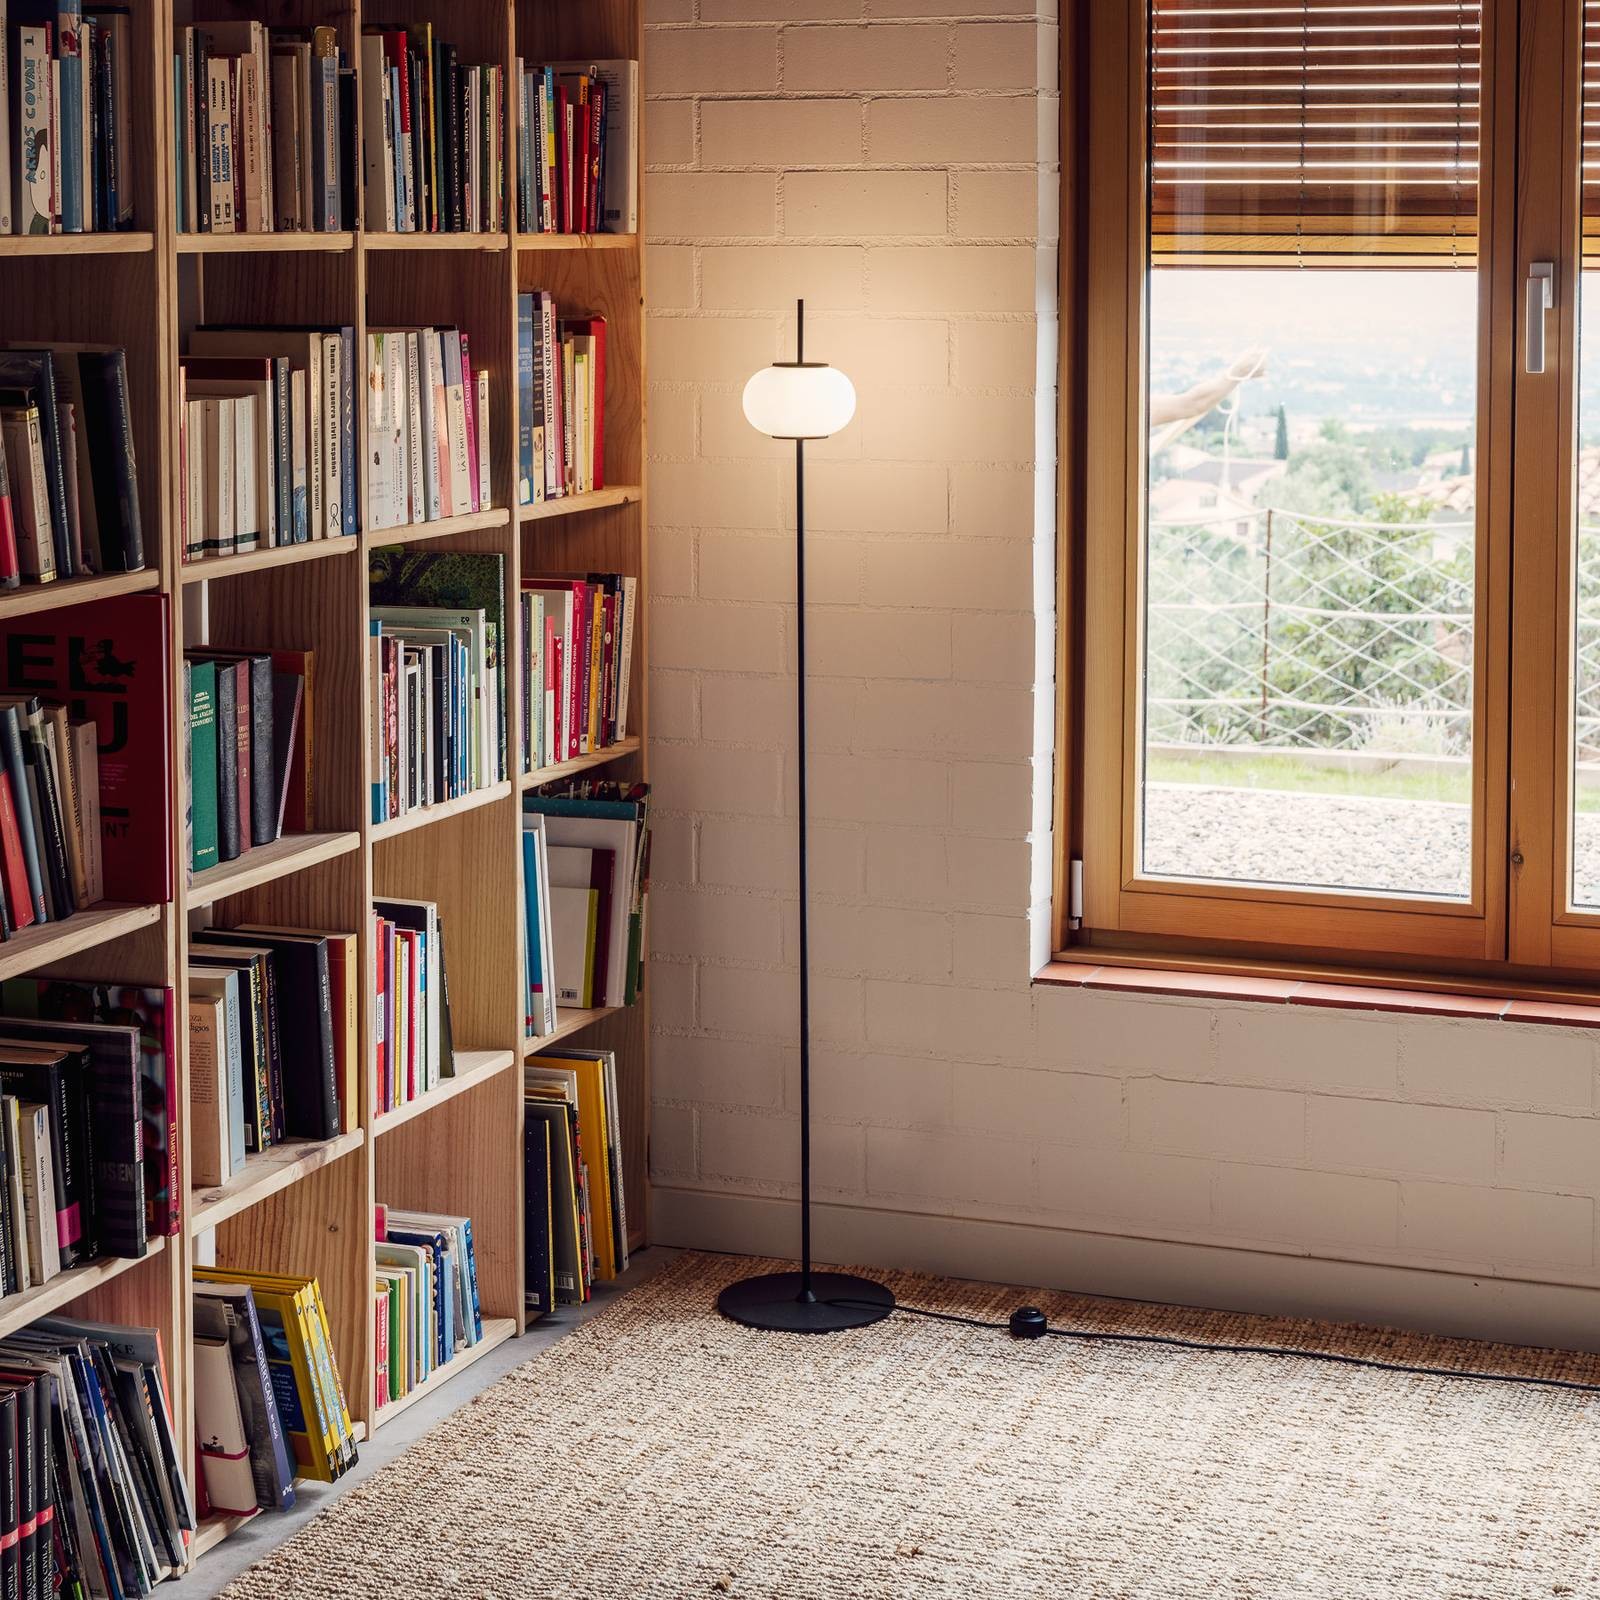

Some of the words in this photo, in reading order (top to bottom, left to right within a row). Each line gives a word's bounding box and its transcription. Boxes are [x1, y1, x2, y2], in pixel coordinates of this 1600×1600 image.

[24, 36, 34, 46] 1
[24, 56, 36, 120] COVAT
[464, 86, 470, 105] No
[284, 217, 294, 230] 21
[543, 311, 551, 345] CURAN
[330, 380, 337, 390] la
[464, 379, 472, 420] diaper
[545, 368, 553, 424] NUTRITIVAS
[329, 391, 337, 419] guerra
[457, 403, 465, 450] MEDICINA
[625, 585, 634, 625] GUTMAN
[584, 636, 592, 665] Natural
[582, 666, 591, 707] Pregnancy
[170, 1122, 177, 1133] El
[170, 1133, 178, 1164] huerto
[171, 1165, 179, 1201] familiar
[256, 1343, 268, 1381] ROBERT
[263, 1381, 275, 1410] CAPA
